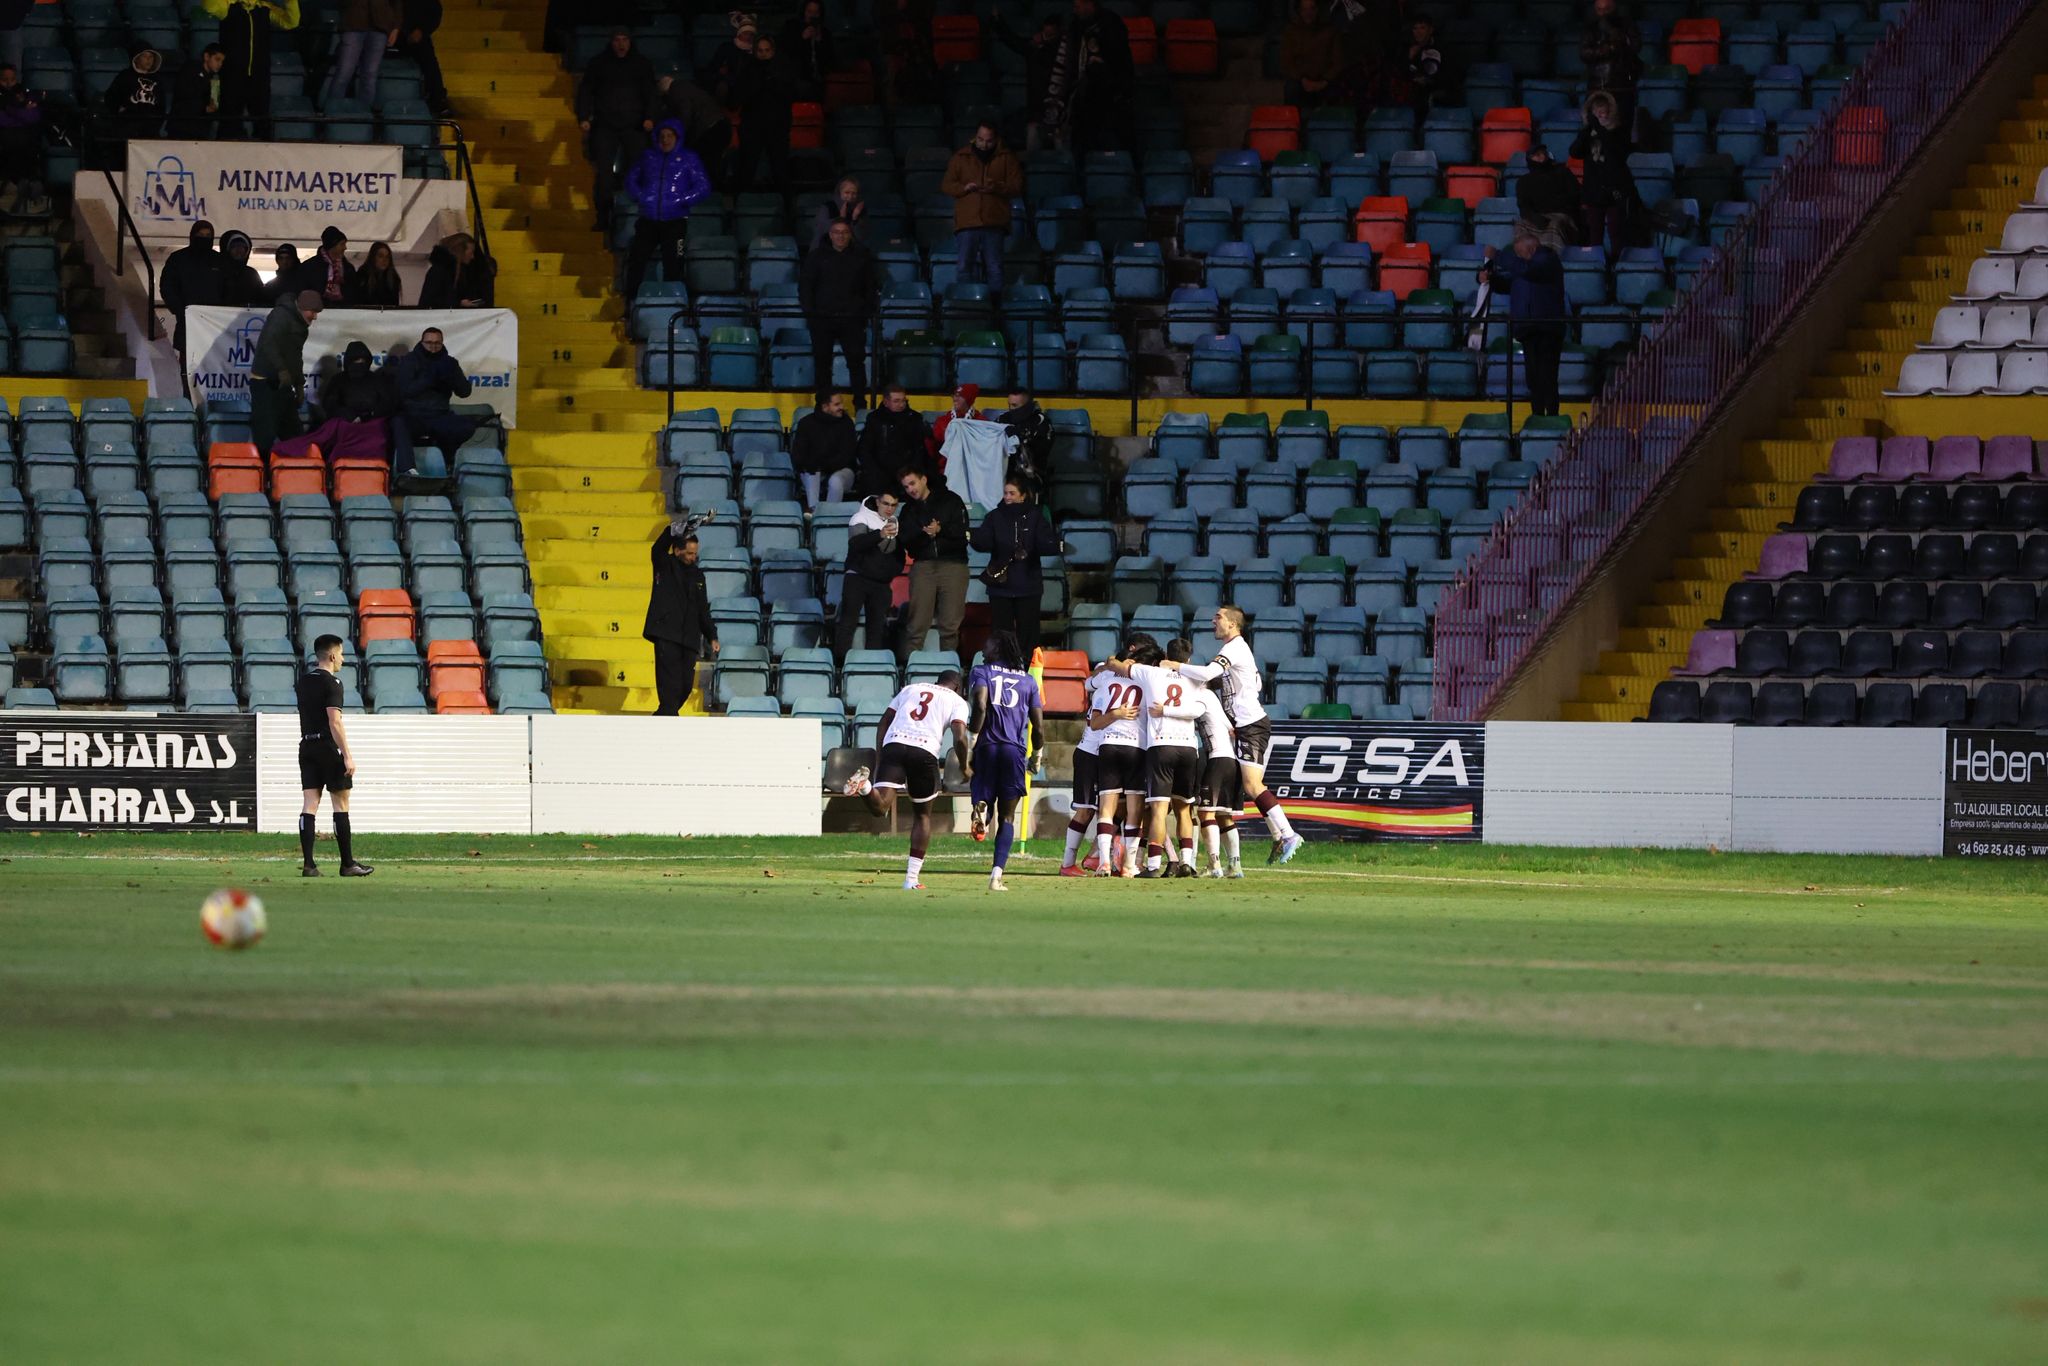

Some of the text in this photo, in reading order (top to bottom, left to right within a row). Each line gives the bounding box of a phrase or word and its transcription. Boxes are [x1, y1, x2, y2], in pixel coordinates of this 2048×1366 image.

[218, 169, 397, 195] MINIMARKET
[237, 198, 309, 211] MIRANDA
[314, 199, 334, 212] DE
[592, 526, 600, 537] 7
[600, 570, 609, 581] 6
[616, 670, 626, 681] 4
[991, 675, 1020, 709] 13
[1105, 683, 1143, 711] 20
[1163, 683, 1183, 707] 8
[909, 691, 934, 722] 3
[1952, 738, 2048, 782] Heber
[1274, 785, 1403, 801] GISTICS
[5, 786, 196, 824] CHARRAS
[1953, 802, 1967, 815] TU
[1967, 803, 2012, 816] ALQUILER
[2013, 804, 2044, 817] LOCAL
[1950, 819, 1975, 829] Empresa
[1991, 820, 2022, 829] salmantina
[2023, 821, 2031, 829] de
[1973, 842, 1989, 856] 692
[1990, 843, 2002, 856] 25
[2002, 844, 2014, 856] 43
[2015, 844, 2026, 857] 45
